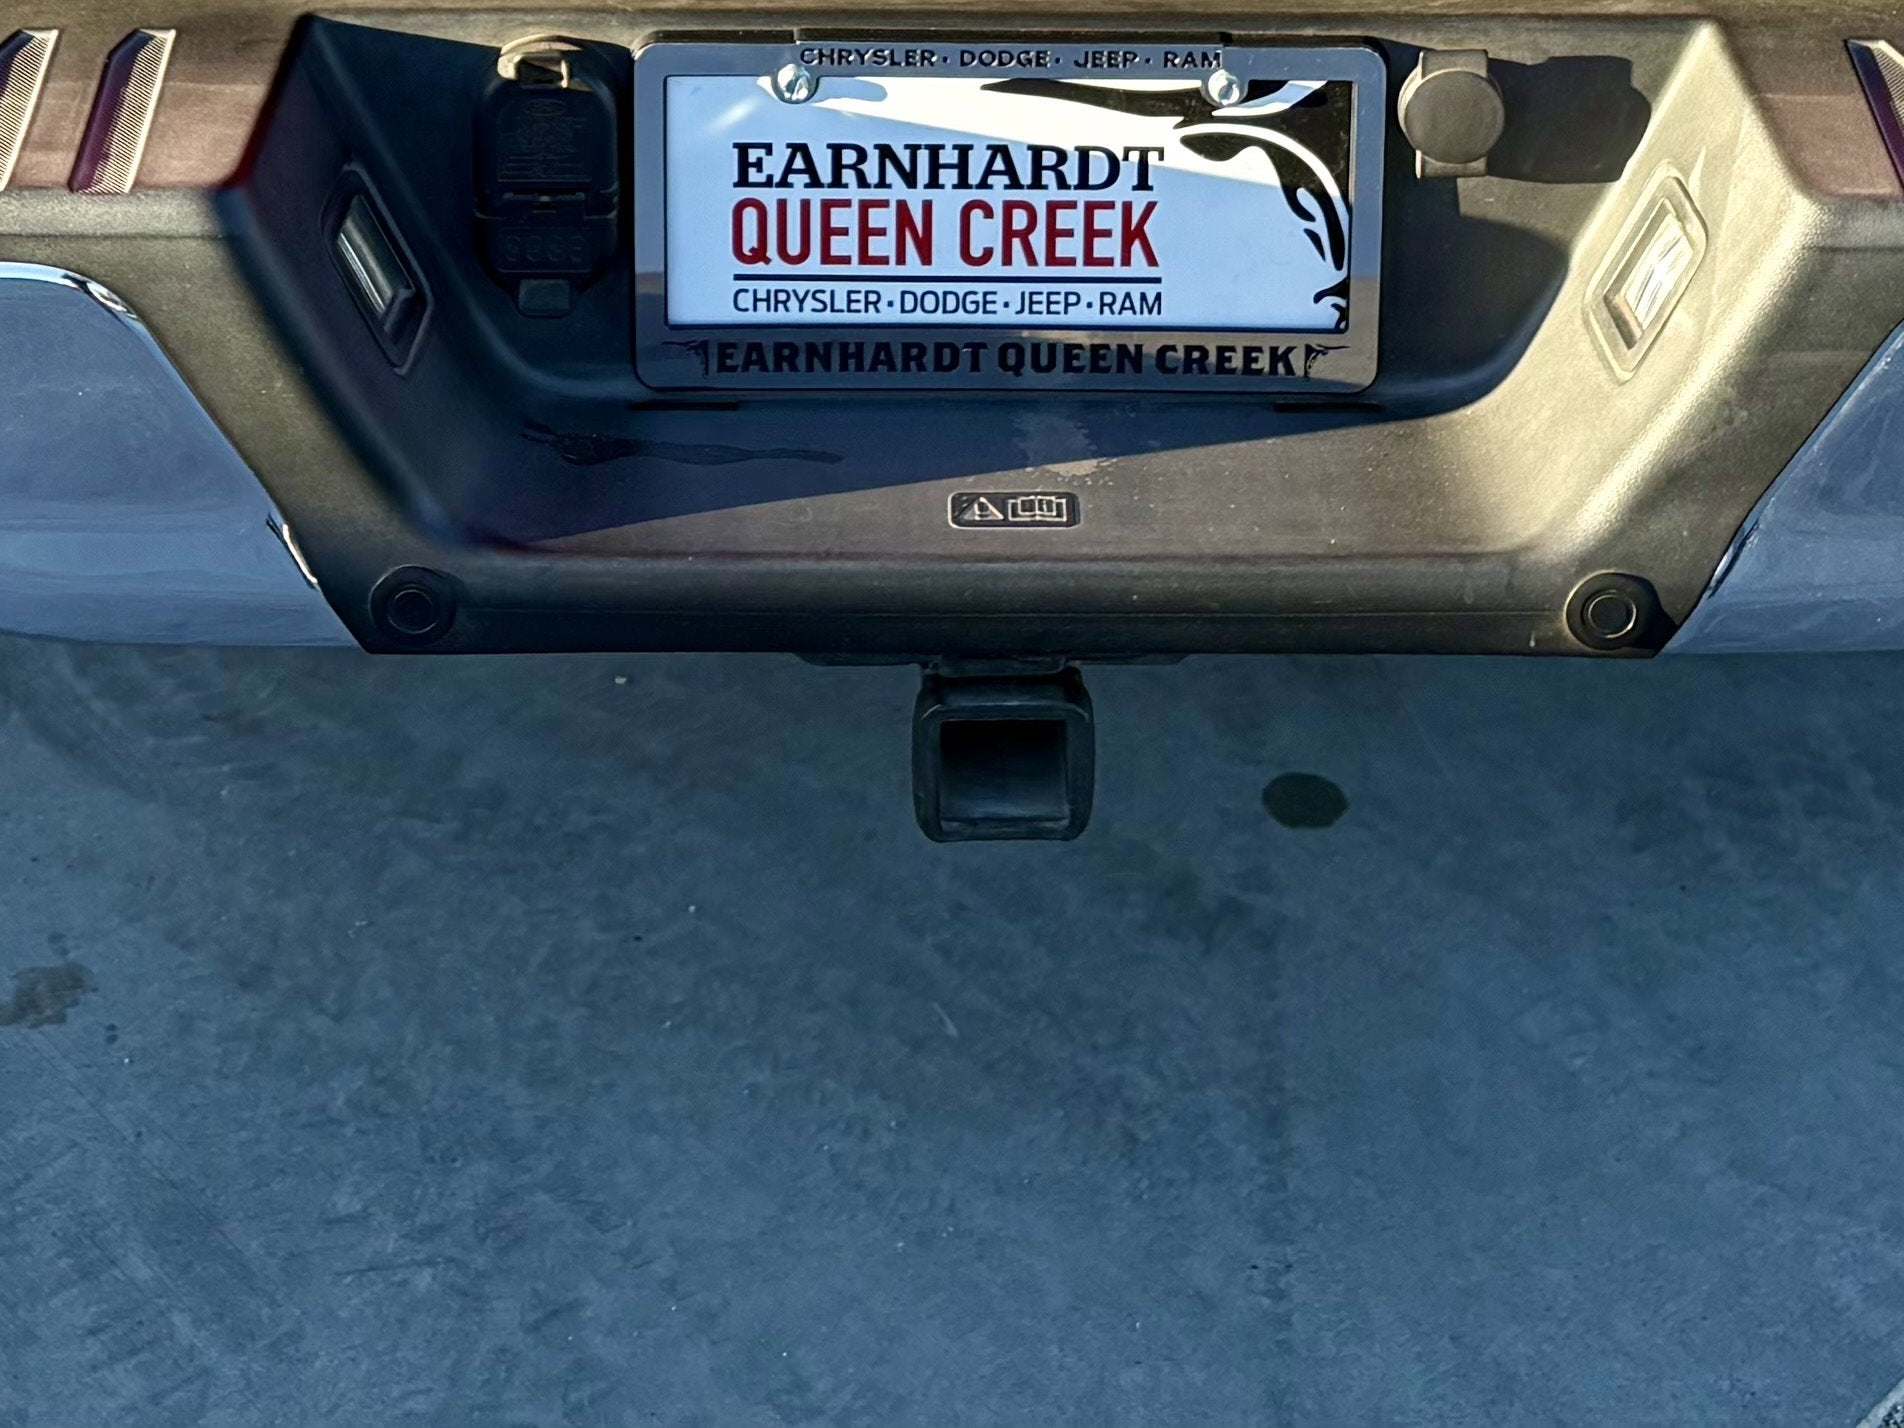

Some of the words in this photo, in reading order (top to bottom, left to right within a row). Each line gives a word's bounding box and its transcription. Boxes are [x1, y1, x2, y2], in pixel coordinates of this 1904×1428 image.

[799, 46, 939, 69] CHRYSLER
[958, 48, 1051, 69] DODGE
[1072, 50, 1139, 70] JEEP
[1162, 51, 1223, 71] RAM
[732, 141, 1165, 192] EARNHARDT
[731, 197, 933, 266] QUEEN
[958, 199, 1160, 268] CREEK
[732, 287, 884, 316] CHRYSLER
[898, 289, 999, 316] DODGE
[1014, 290, 1082, 316] JEEP
[1098, 291, 1163, 317] RAM
[716, 339, 989, 376] EARNHARDT
[997, 340, 1156, 376] QUEEN
[1163, 343, 1302, 378] CREEK
